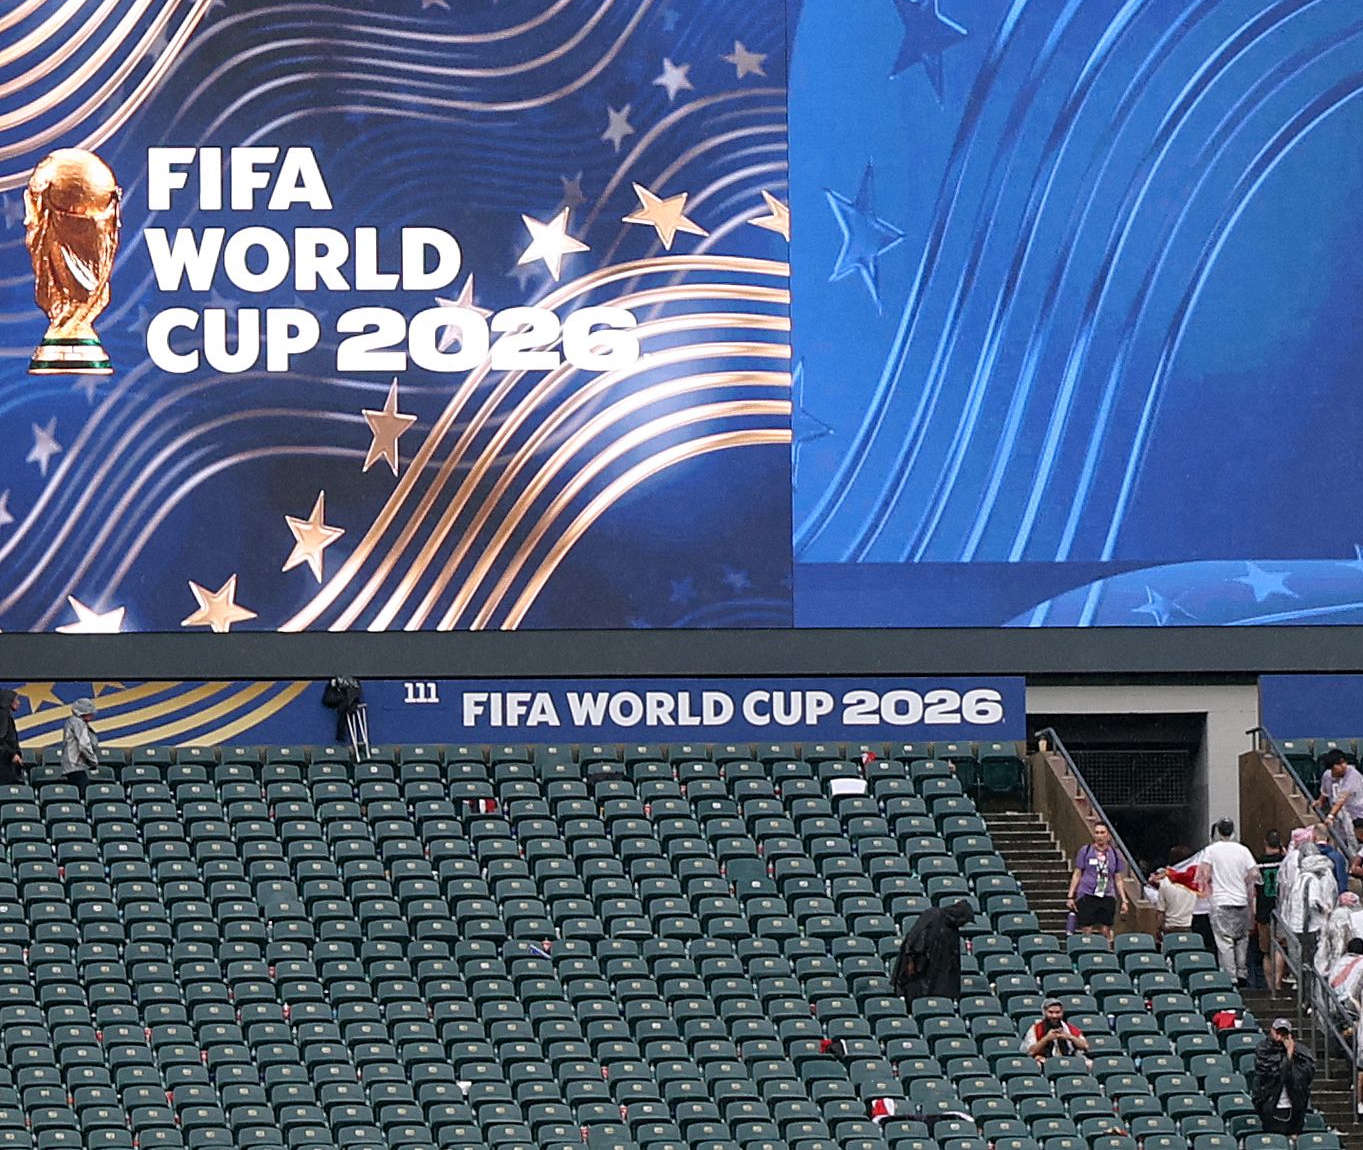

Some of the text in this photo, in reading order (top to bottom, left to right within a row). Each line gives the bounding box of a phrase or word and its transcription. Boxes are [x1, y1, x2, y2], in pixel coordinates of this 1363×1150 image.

[147, 147, 333, 211] FIFA
[143, 226, 461, 293] WORLD
[146, 306, 641, 374] CUP 2026
[403, 682, 440, 703] 111
[463, 689, 1003, 727] FIFA WORLD CUP 2026
